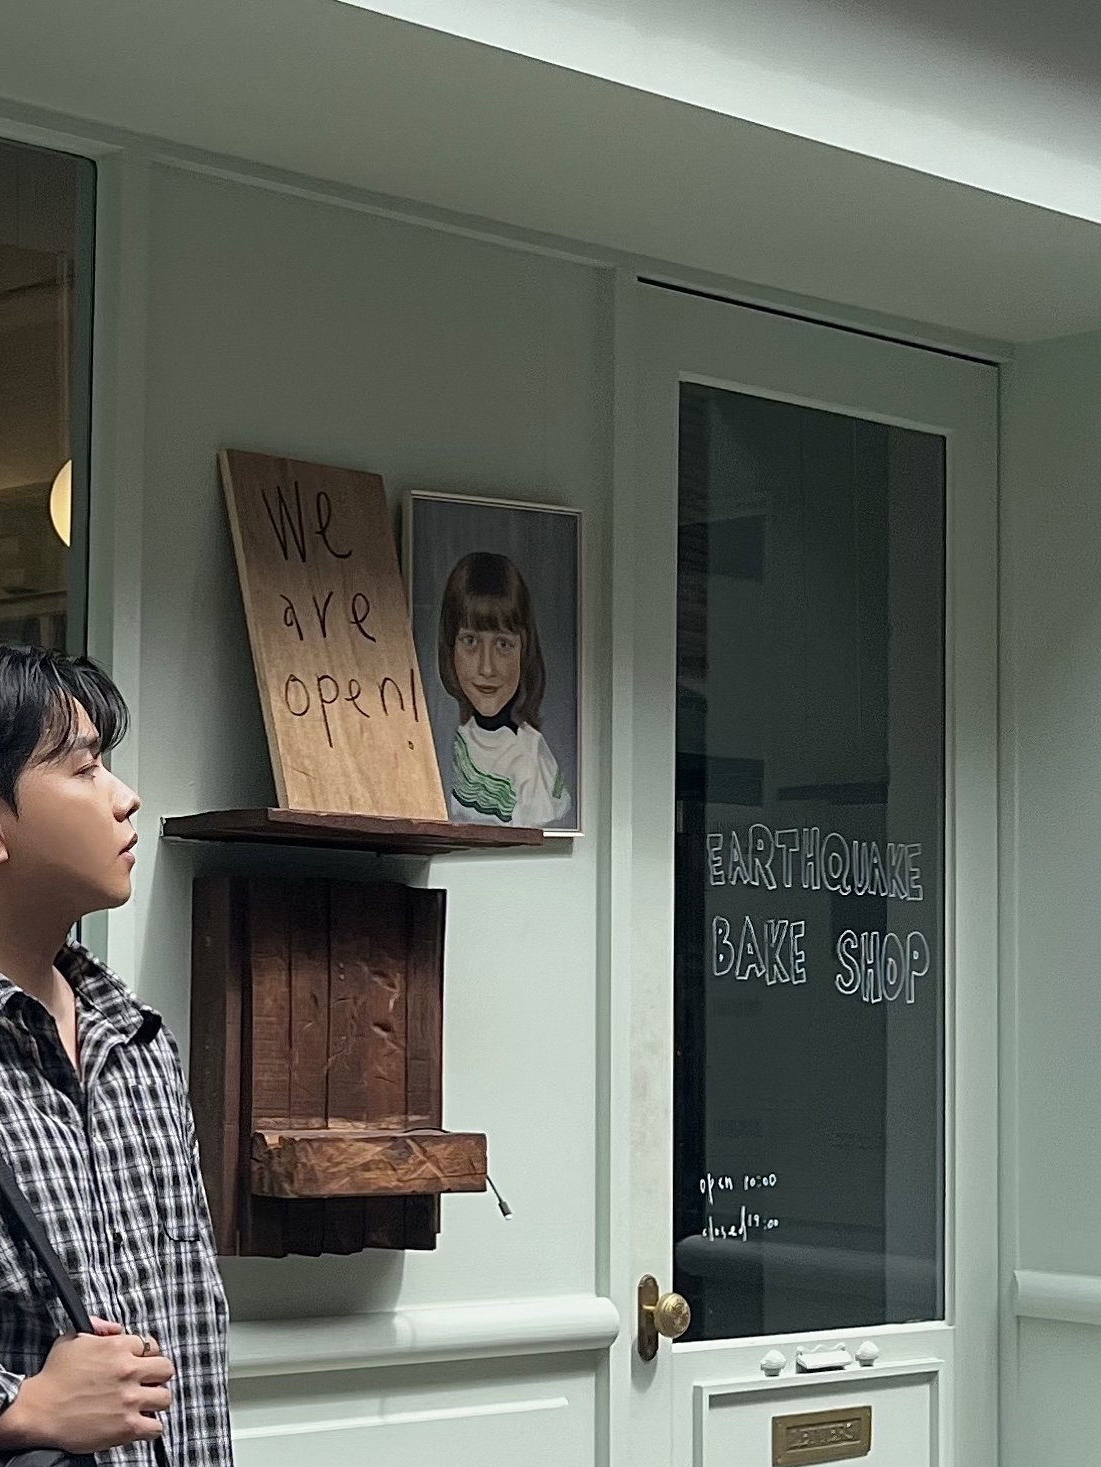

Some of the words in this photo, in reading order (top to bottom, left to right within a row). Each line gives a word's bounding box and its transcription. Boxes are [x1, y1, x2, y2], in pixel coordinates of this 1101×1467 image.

[261, 481, 352, 562] We
[279, 591, 377, 643] are
[283, 669, 419, 750] open!
[706, 823, 923, 900] EARTHQUAKE
[712, 916, 806, 986] BAKE
[835, 930, 931, 1003] SHOP
[700, 1172, 733, 1205] open
[743, 1173, 777, 1190] 10:00
[702, 1205, 747, 1242] closed
